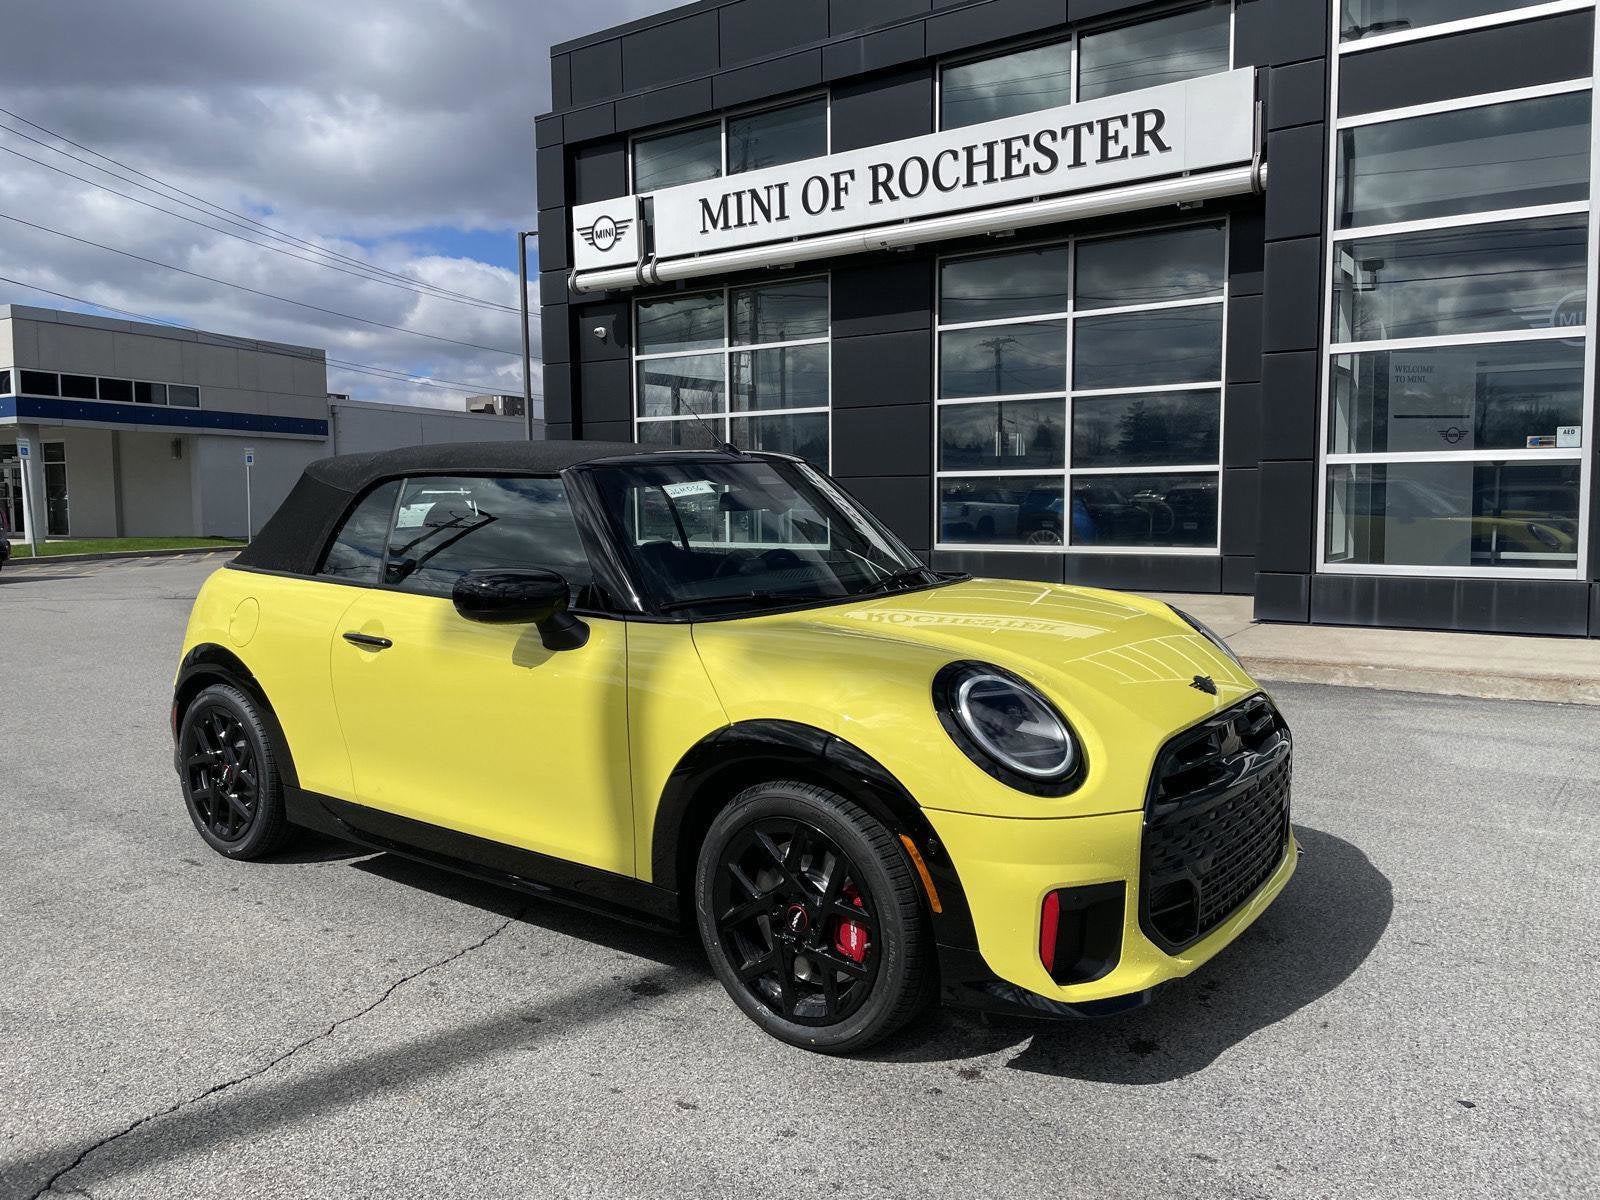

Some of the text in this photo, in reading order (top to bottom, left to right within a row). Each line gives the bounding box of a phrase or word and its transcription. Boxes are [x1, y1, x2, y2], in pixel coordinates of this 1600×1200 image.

[698, 108, 1172, 234] MINI OF ROCHESTER
[595, 227, 614, 240] MINI
[1560, 311, 1584, 326] MI
[1394, 365, 1435, 374] WELCOME
[1394, 375, 1406, 384] TO
